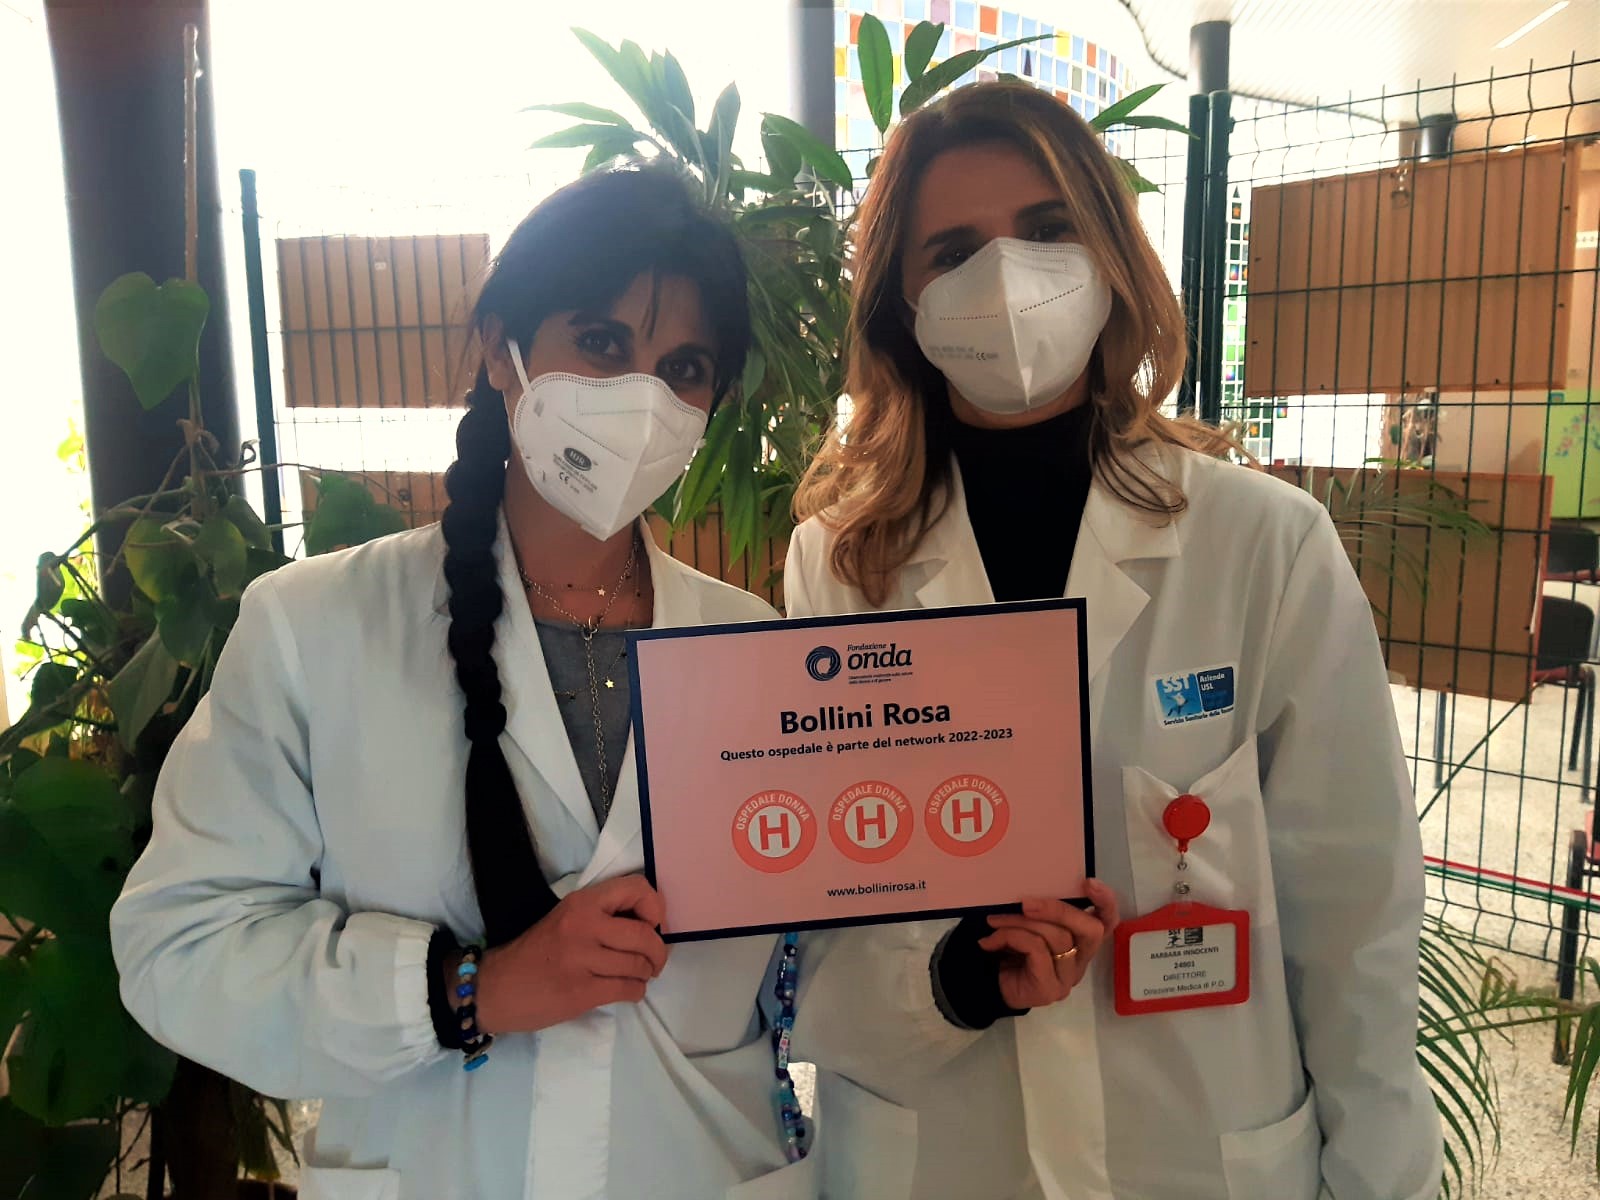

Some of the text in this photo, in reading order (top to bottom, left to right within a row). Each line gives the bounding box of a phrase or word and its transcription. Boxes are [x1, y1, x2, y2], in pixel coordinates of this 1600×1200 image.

[847, 643, 887, 651] Fondazione
[847, 643, 912, 670] onda
[1201, 683, 1214, 691] USL
[780, 702, 950, 735] Bollini Rosa
[720, 728, 1013, 762] Questo ospedale è parte del network 2022-2023
[736, 793, 811, 830] OSPEDALE DONNA
[832, 784, 908, 821] OSPEDALE DONNA
[928, 777, 1003, 815] OSPEDALE DONNA
[758, 813, 791, 851] H
[855, 803, 887, 841] H
[951, 797, 983, 835] H
[827, 880, 927, 898] www.bollinirosa.it
[1163, 971, 1206, 981] DIRETTORE
